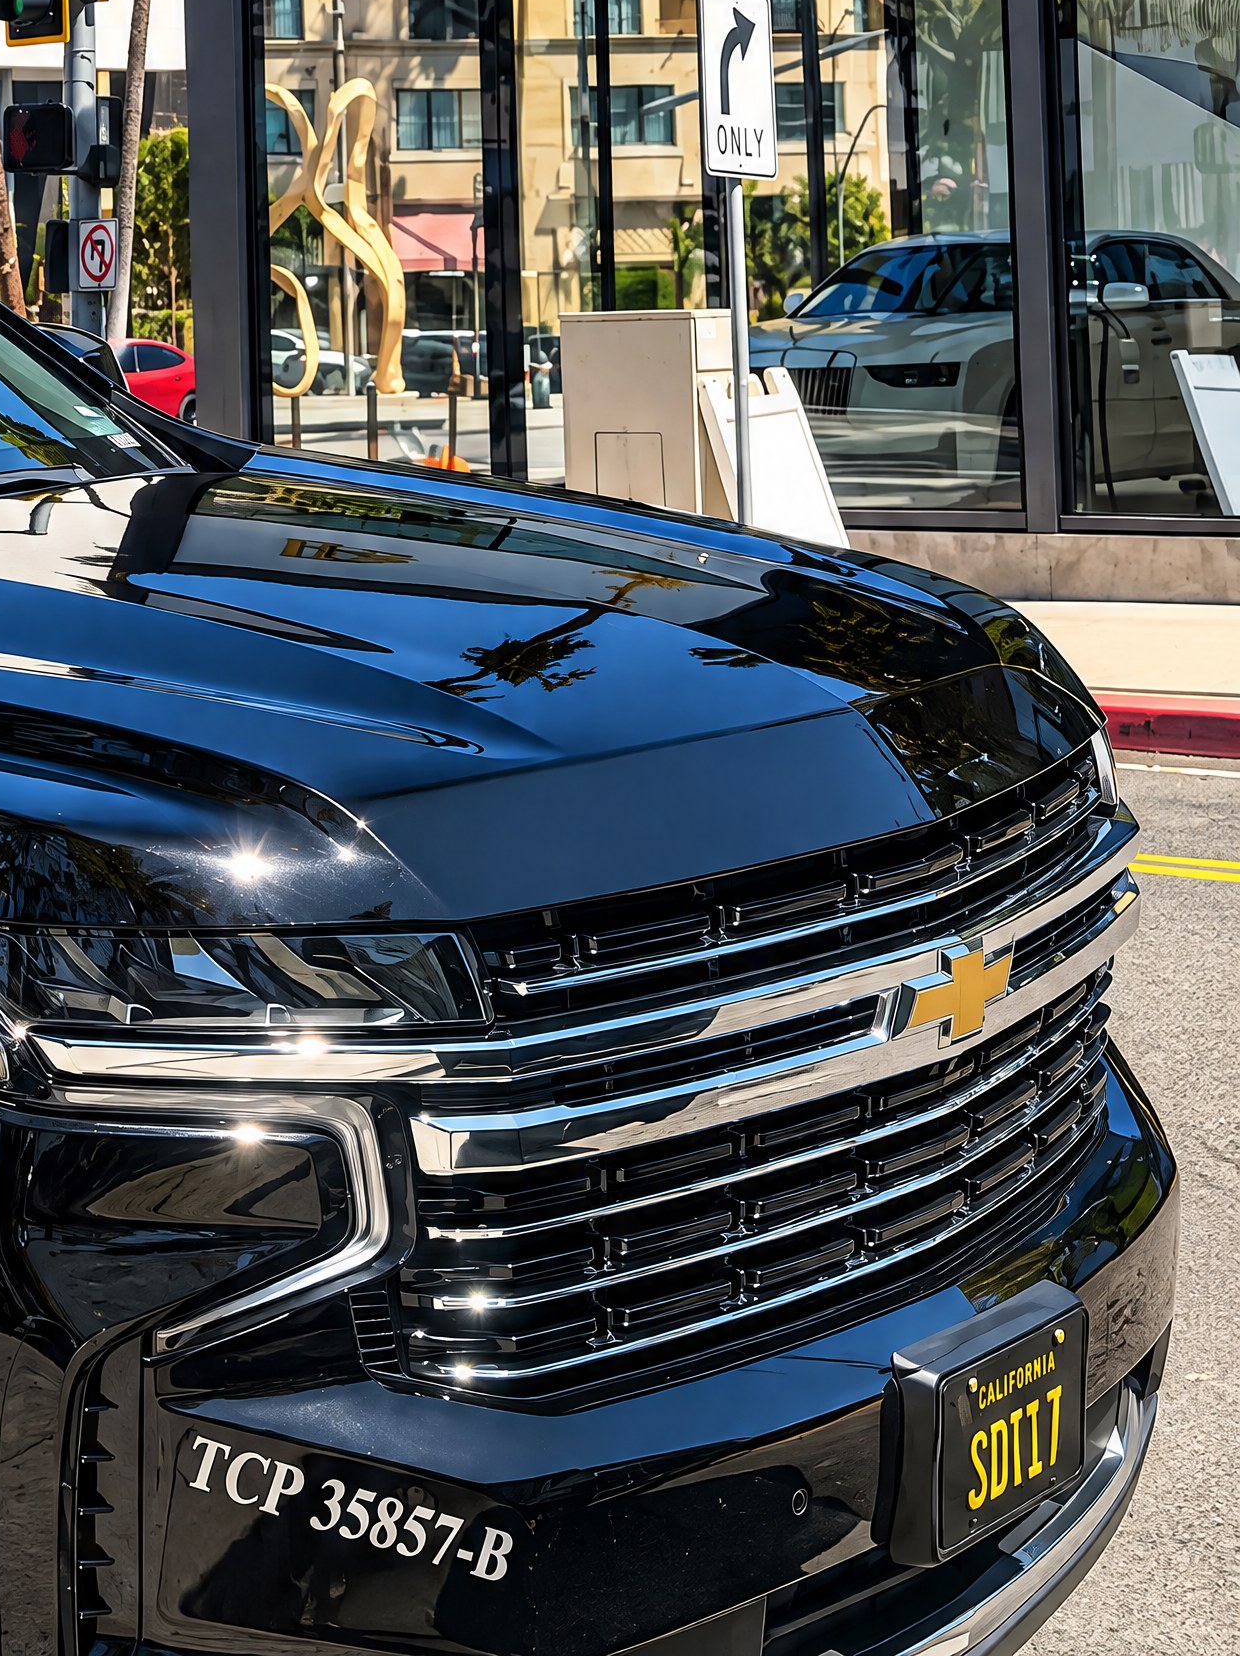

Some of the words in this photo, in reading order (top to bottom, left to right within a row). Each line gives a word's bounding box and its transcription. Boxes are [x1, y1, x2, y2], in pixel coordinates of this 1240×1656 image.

[717, 124, 764, 158] ONLY
[978, 1351, 1056, 1410] CALIFORNIA
[189, 1435, 305, 1516] TCP
[310, 1479, 513, 1582] 35857-B
